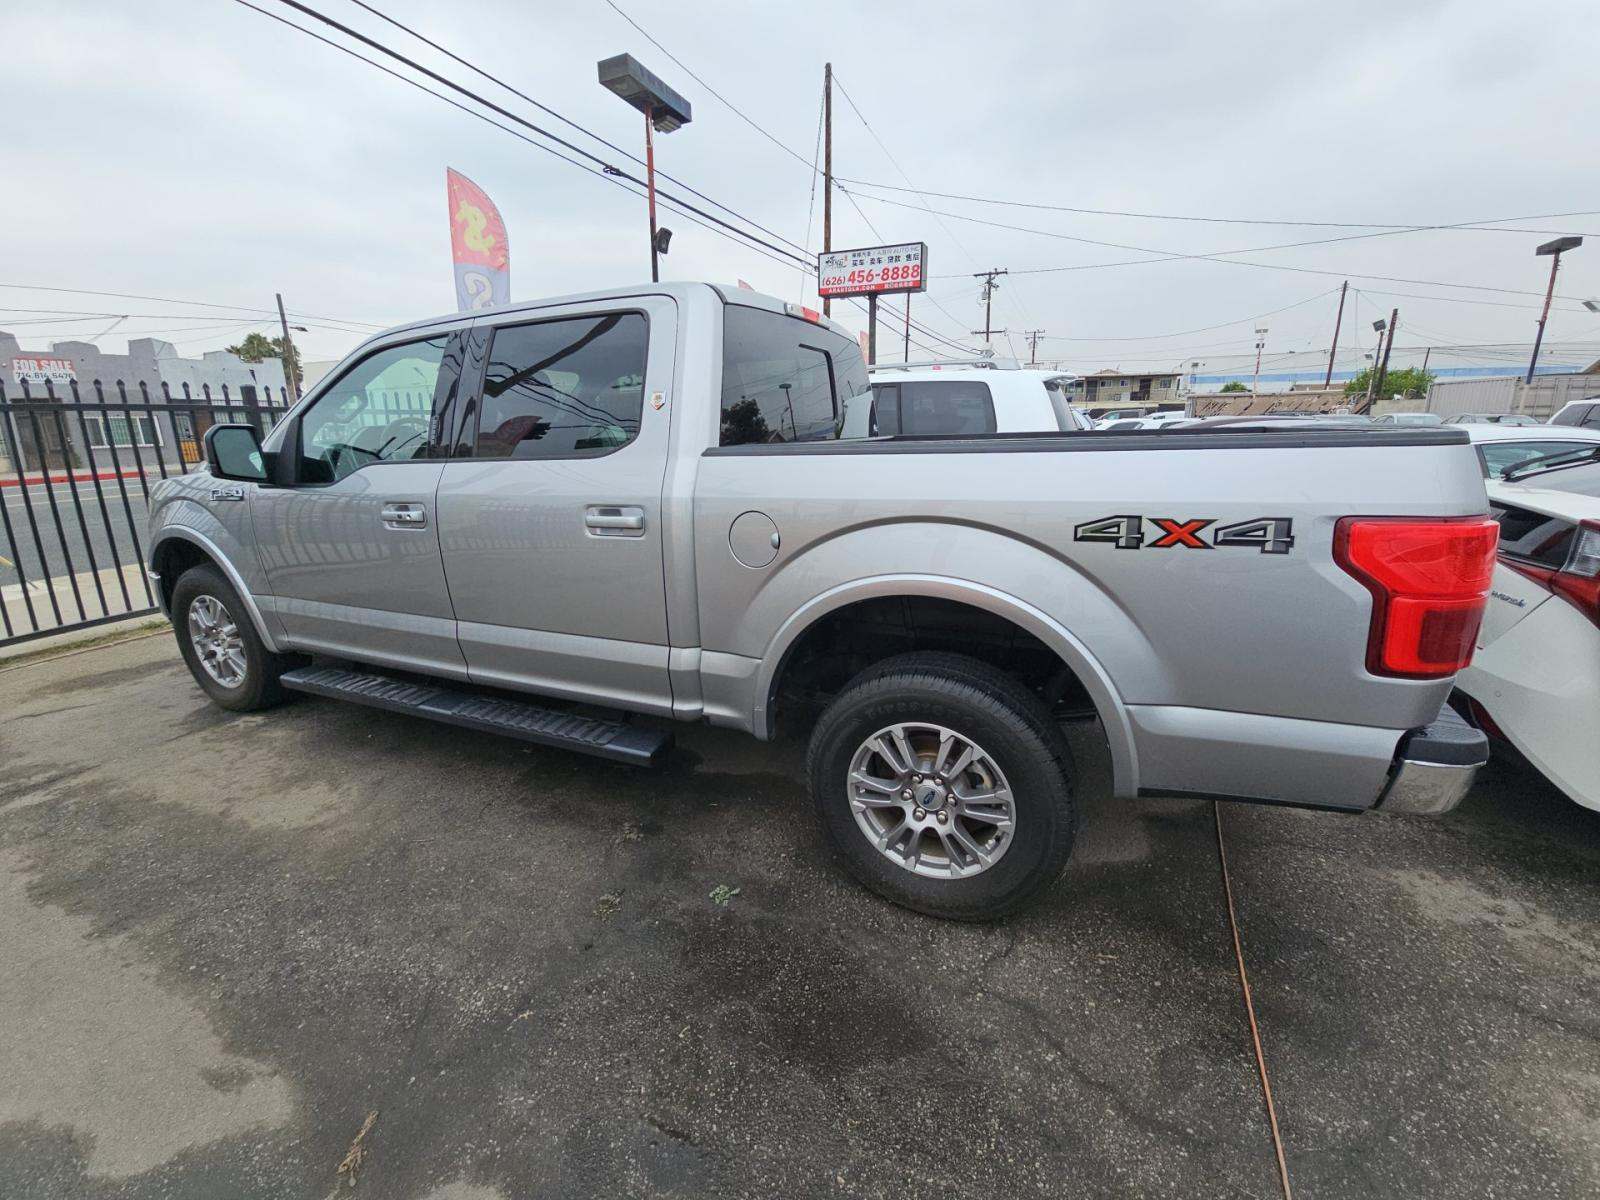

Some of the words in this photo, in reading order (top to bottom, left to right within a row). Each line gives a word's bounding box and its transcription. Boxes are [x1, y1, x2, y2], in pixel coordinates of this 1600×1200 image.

[822, 276, 846, 286] (626)
[848, 264, 920, 284] 456-8888
[13, 359, 38, 372] FOR
[40, 359, 73, 372] SALE
